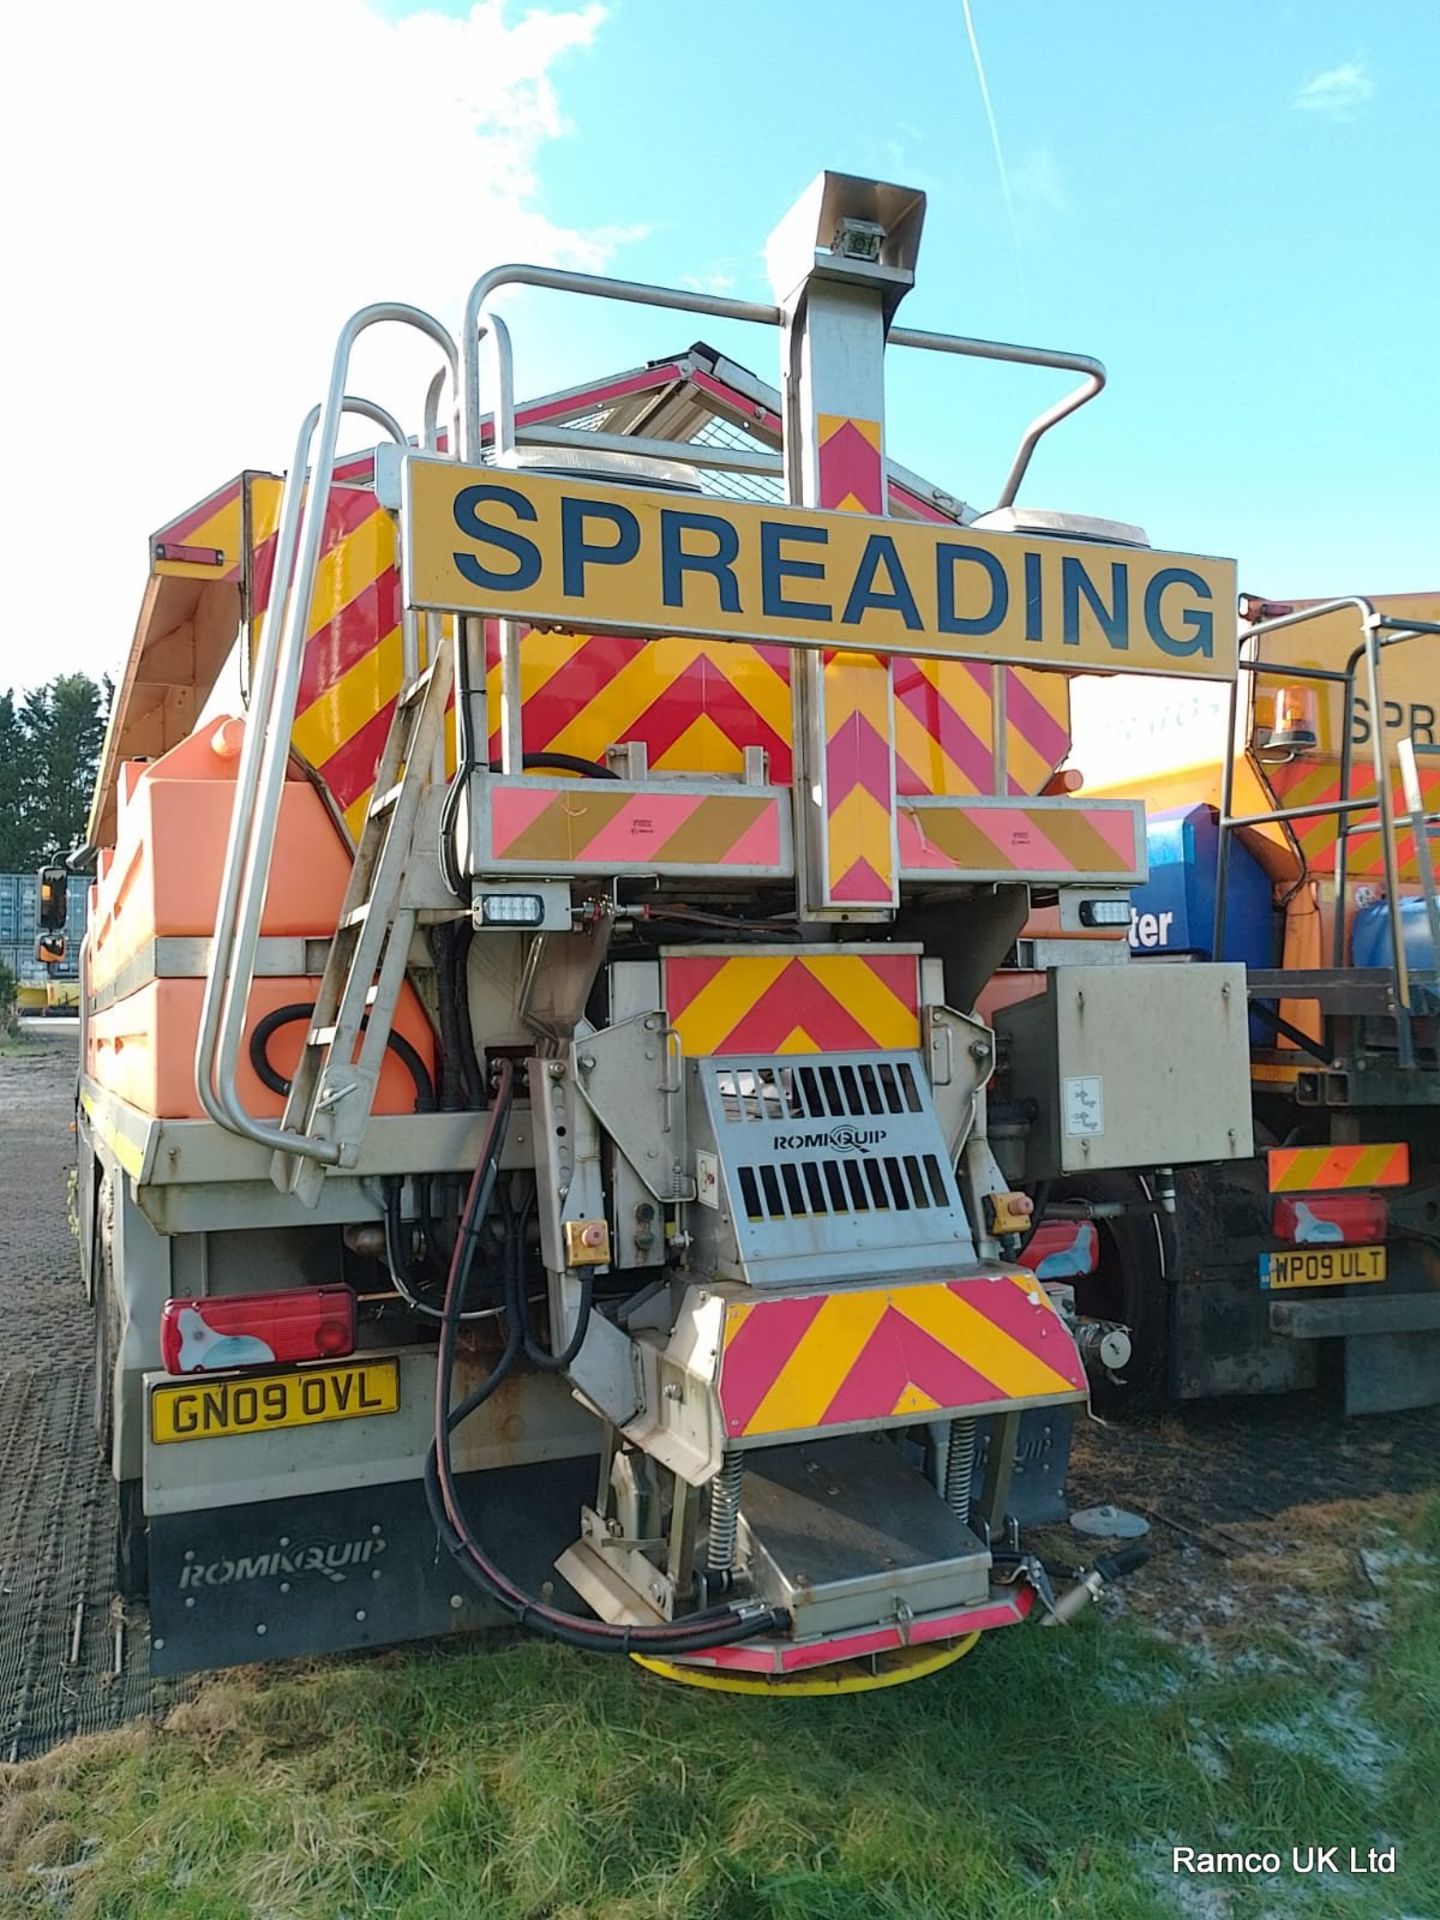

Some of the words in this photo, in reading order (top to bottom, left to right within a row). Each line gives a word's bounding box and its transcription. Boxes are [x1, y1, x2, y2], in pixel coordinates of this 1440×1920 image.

[453, 485, 1214, 658] SPREADING
[1275, 1255, 1333, 1283] WP09
[1340, 1252, 1381, 1277] ULT
[173, 1384, 287, 1433] GN09
[302, 1372, 382, 1415] OVL
